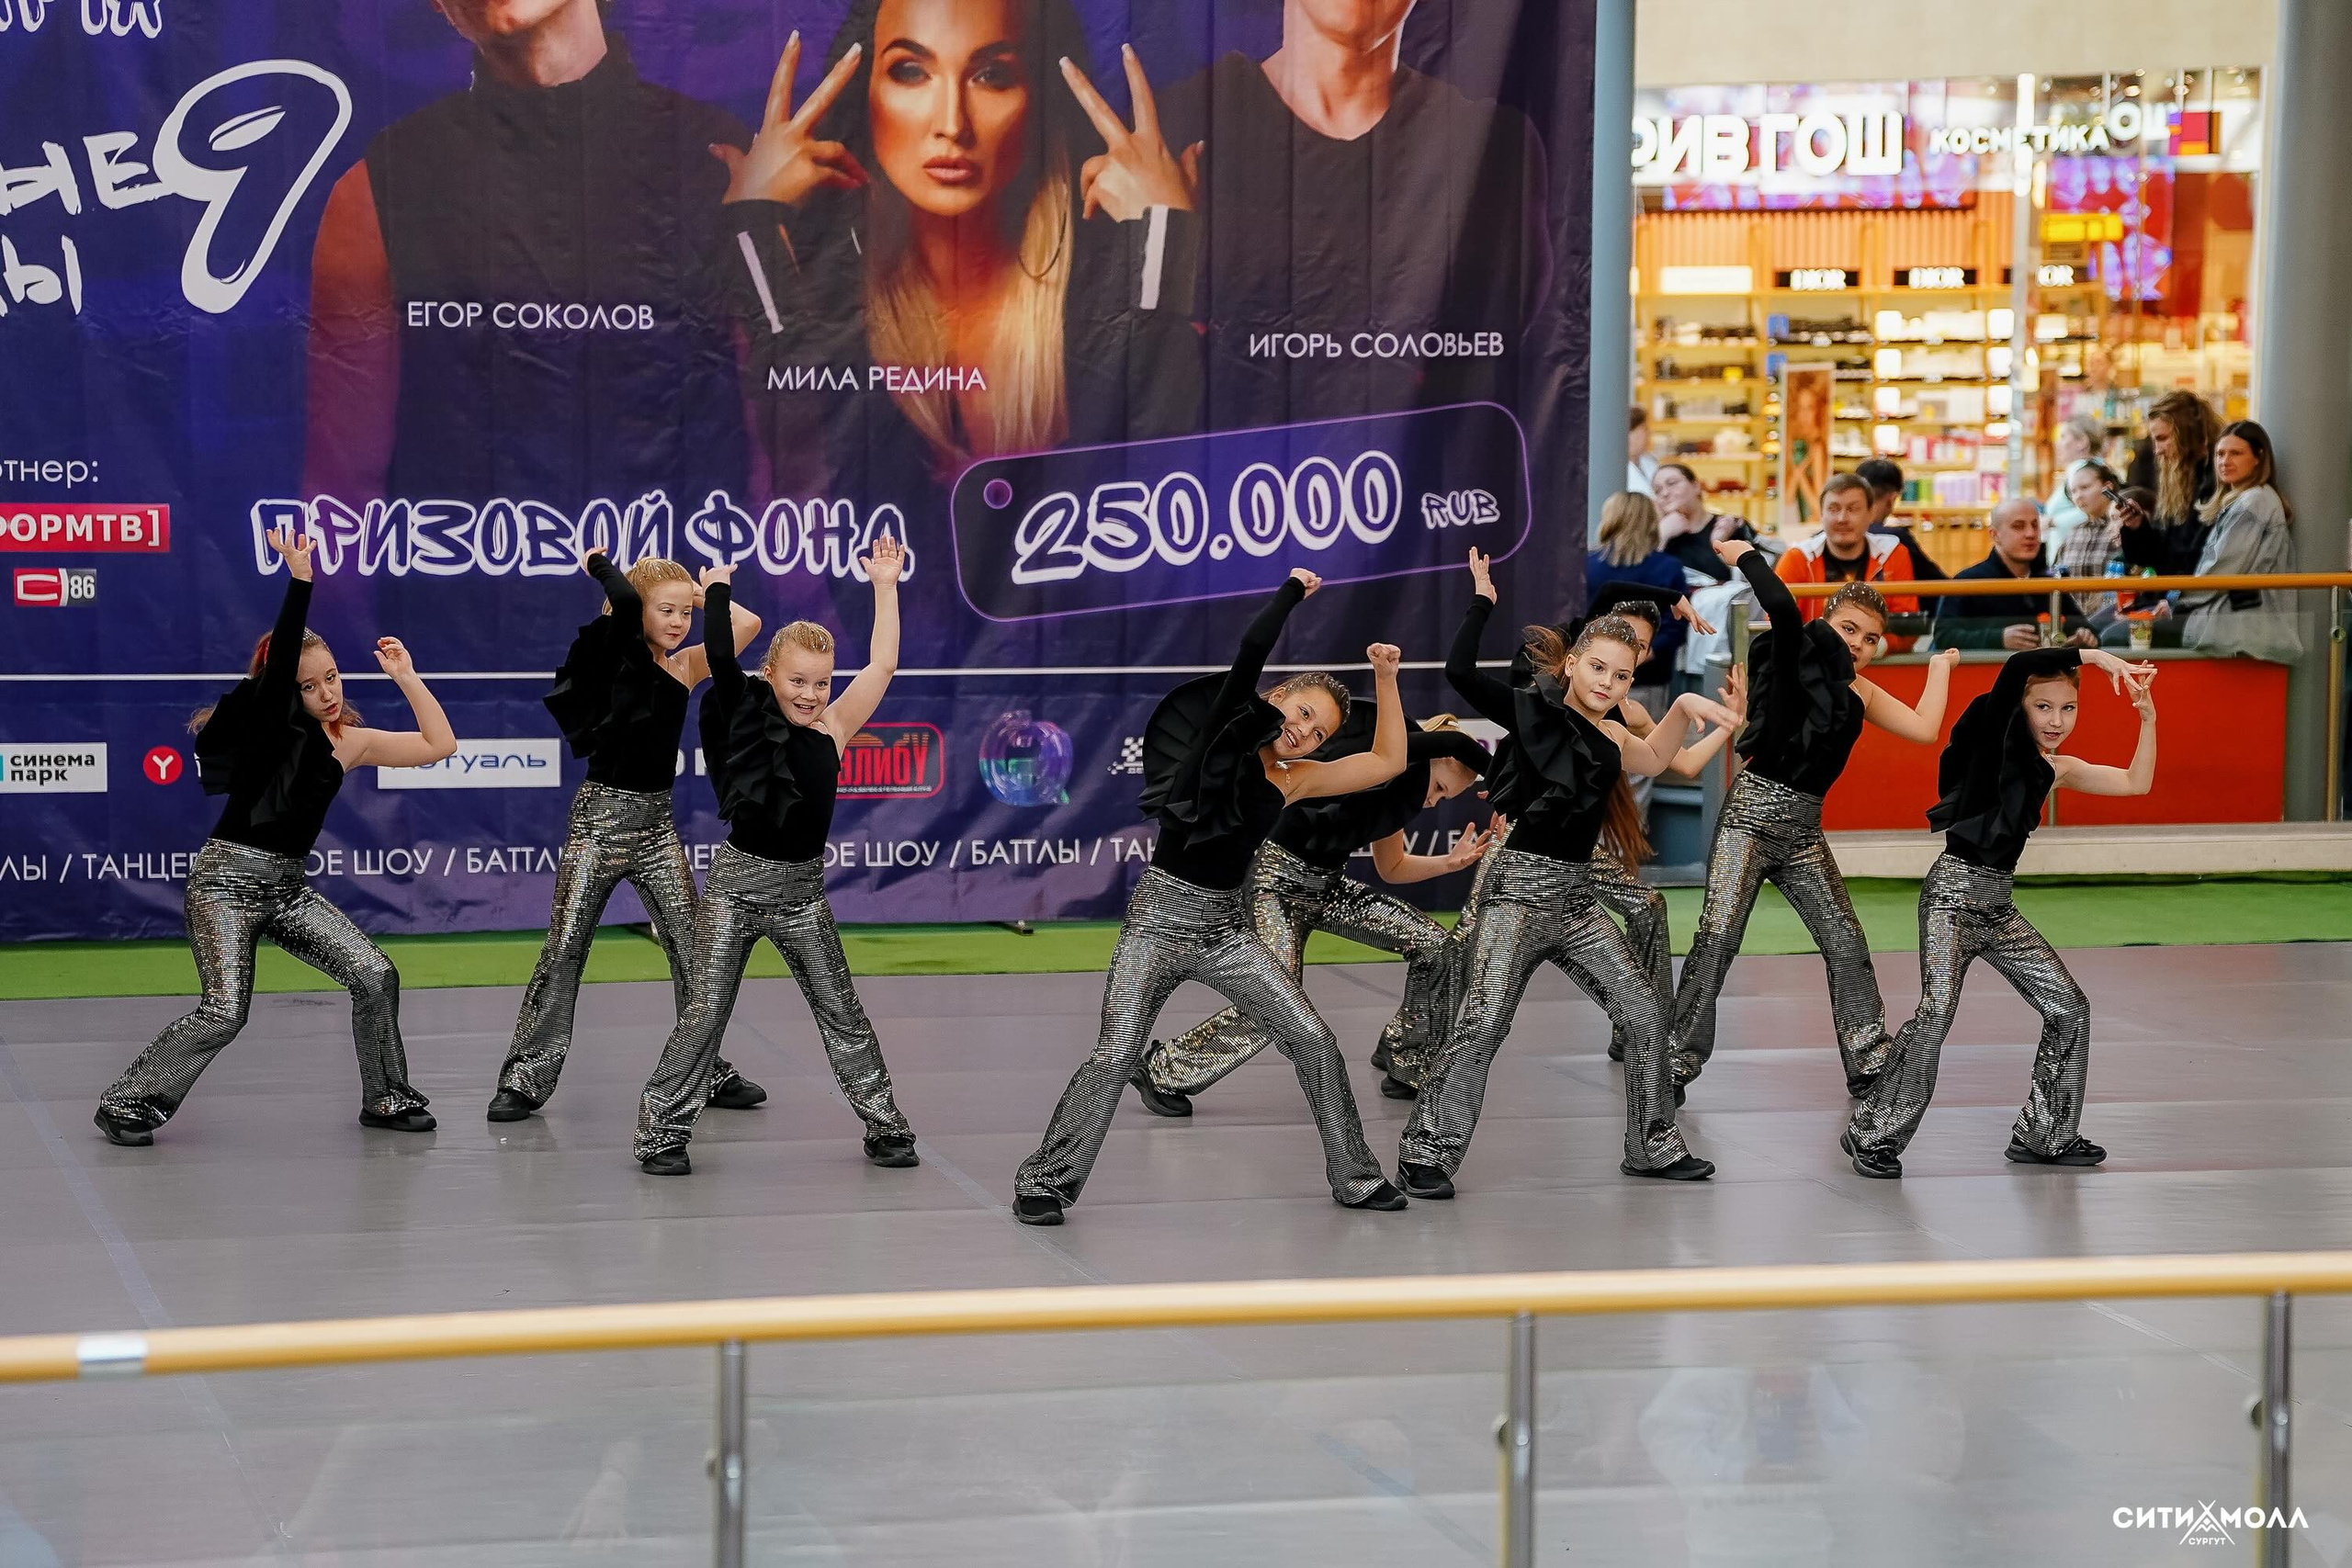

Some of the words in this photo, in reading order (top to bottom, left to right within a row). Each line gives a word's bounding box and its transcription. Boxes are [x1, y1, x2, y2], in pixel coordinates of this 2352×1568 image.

[1759, 110, 1904, 176] ГОШ
[407, 301, 483, 328] ЕГОР
[492, 302, 655, 331] СОКОЛОВ
[1250, 333, 1342, 358] ИГОРЬ
[1350, 332, 1505, 358] СОЛОВЬЕВ
[767, 366, 860, 391] МИЛА
[868, 366, 988, 394] РЕДИНА
[0, 459, 99, 489] тнер:
[1011, 449, 1403, 585] 250.000
[1421, 488, 1501, 530] RUB
[250, 489, 673, 577] ПРИЗОВОЙ
[10, 753, 96, 767] синема
[10, 770, 69, 785] парк
[354, 847, 434, 875] ШОУ
[467, 846, 563, 874] БАТТЛ
[865, 840, 940, 867] ШОУ
[971, 838, 1080, 865] БАТТЛЫ
